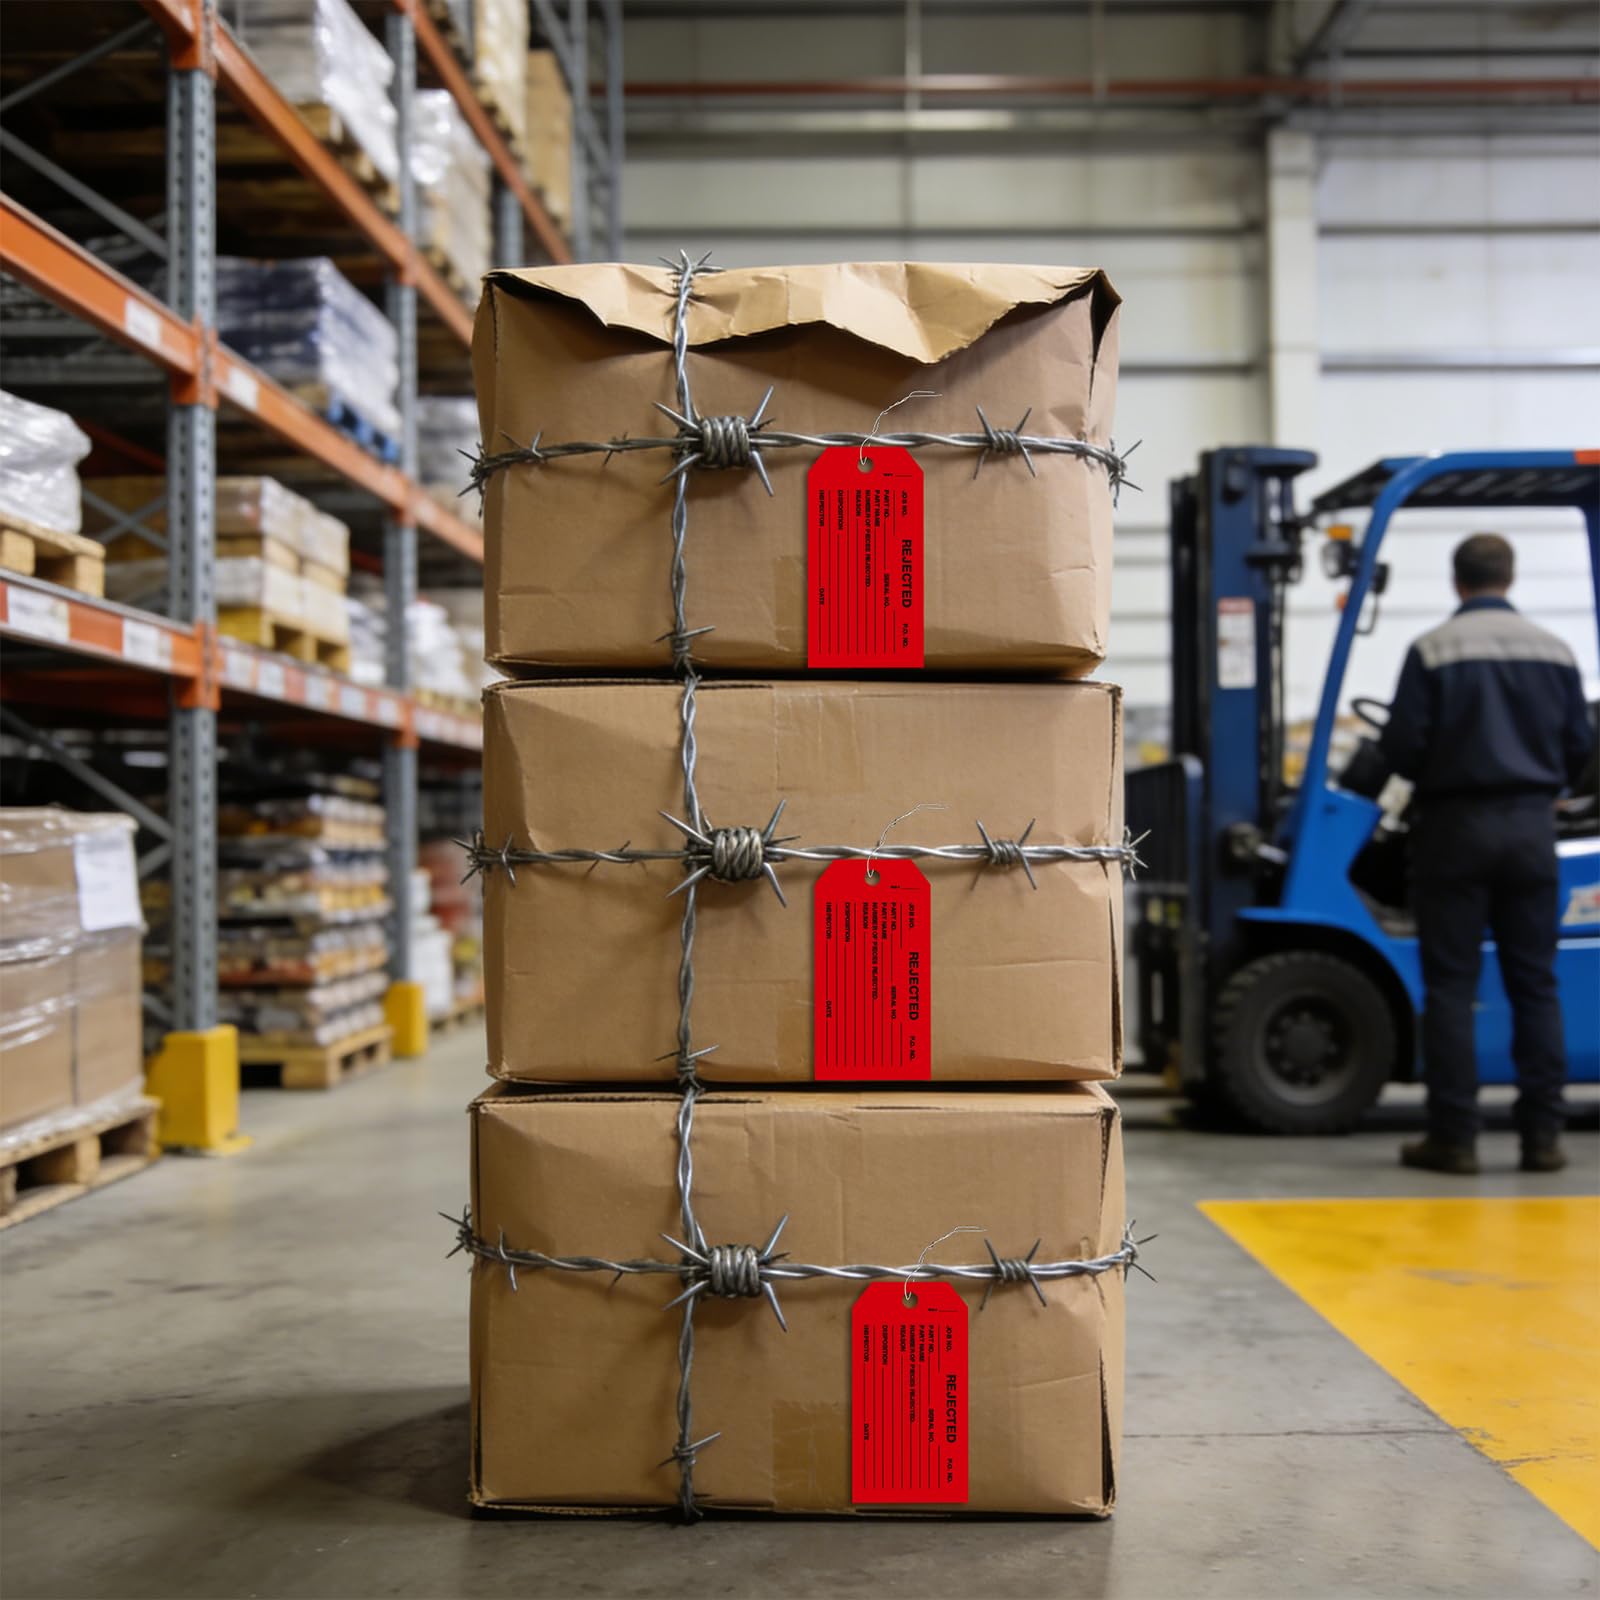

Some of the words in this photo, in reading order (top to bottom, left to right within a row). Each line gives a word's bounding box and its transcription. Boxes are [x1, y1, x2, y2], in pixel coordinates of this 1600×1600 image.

[902, 539, 912, 608] REJECTED
[909, 952, 919, 1021] REJECTED
[946, 1374, 956, 1443] REJECTED
